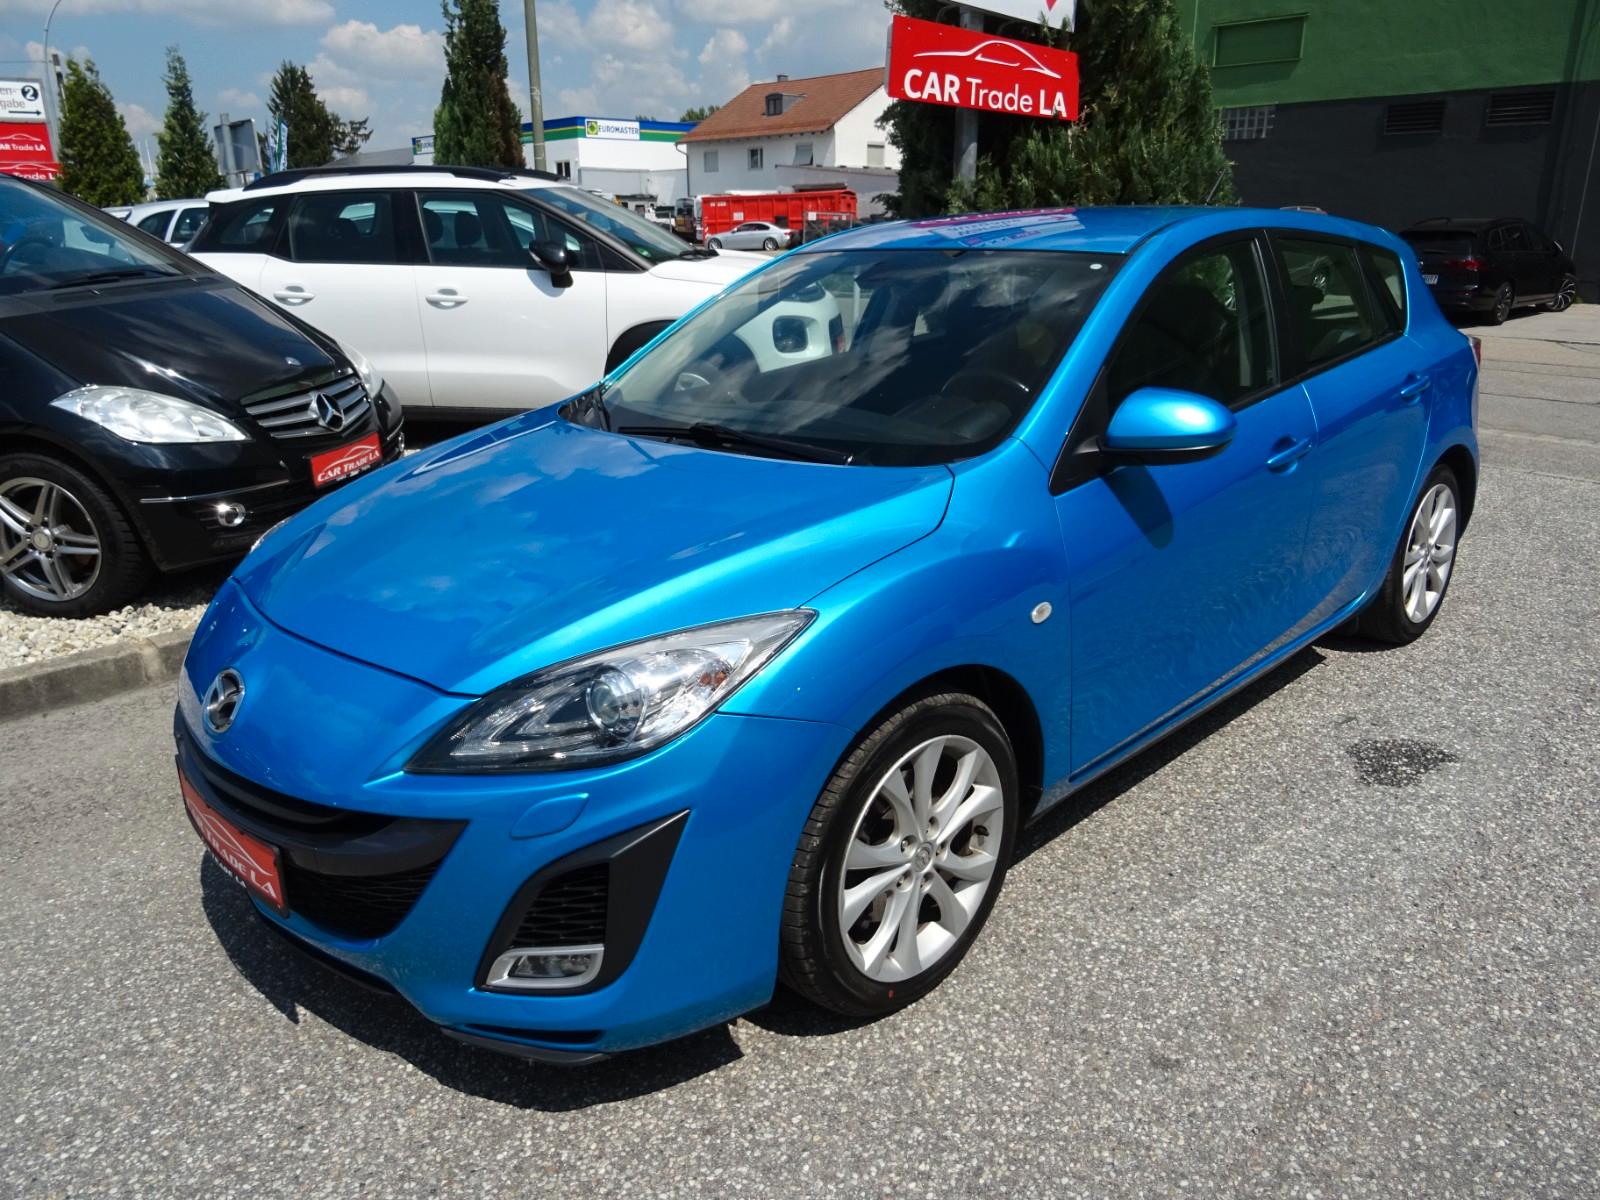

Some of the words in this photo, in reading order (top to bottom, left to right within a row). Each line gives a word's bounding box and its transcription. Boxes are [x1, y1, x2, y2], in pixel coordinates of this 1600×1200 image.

[24, 86, 36, 100] 2
[903, 69, 960, 104] CAR
[966, 77, 1033, 113] Trade
[1039, 89, 1068, 118] LA
[598, 124, 639, 135] EUROMASTER
[317, 467, 341, 482] CAR
[368, 450, 380, 460] LA
[250, 870, 277, 898] LA
